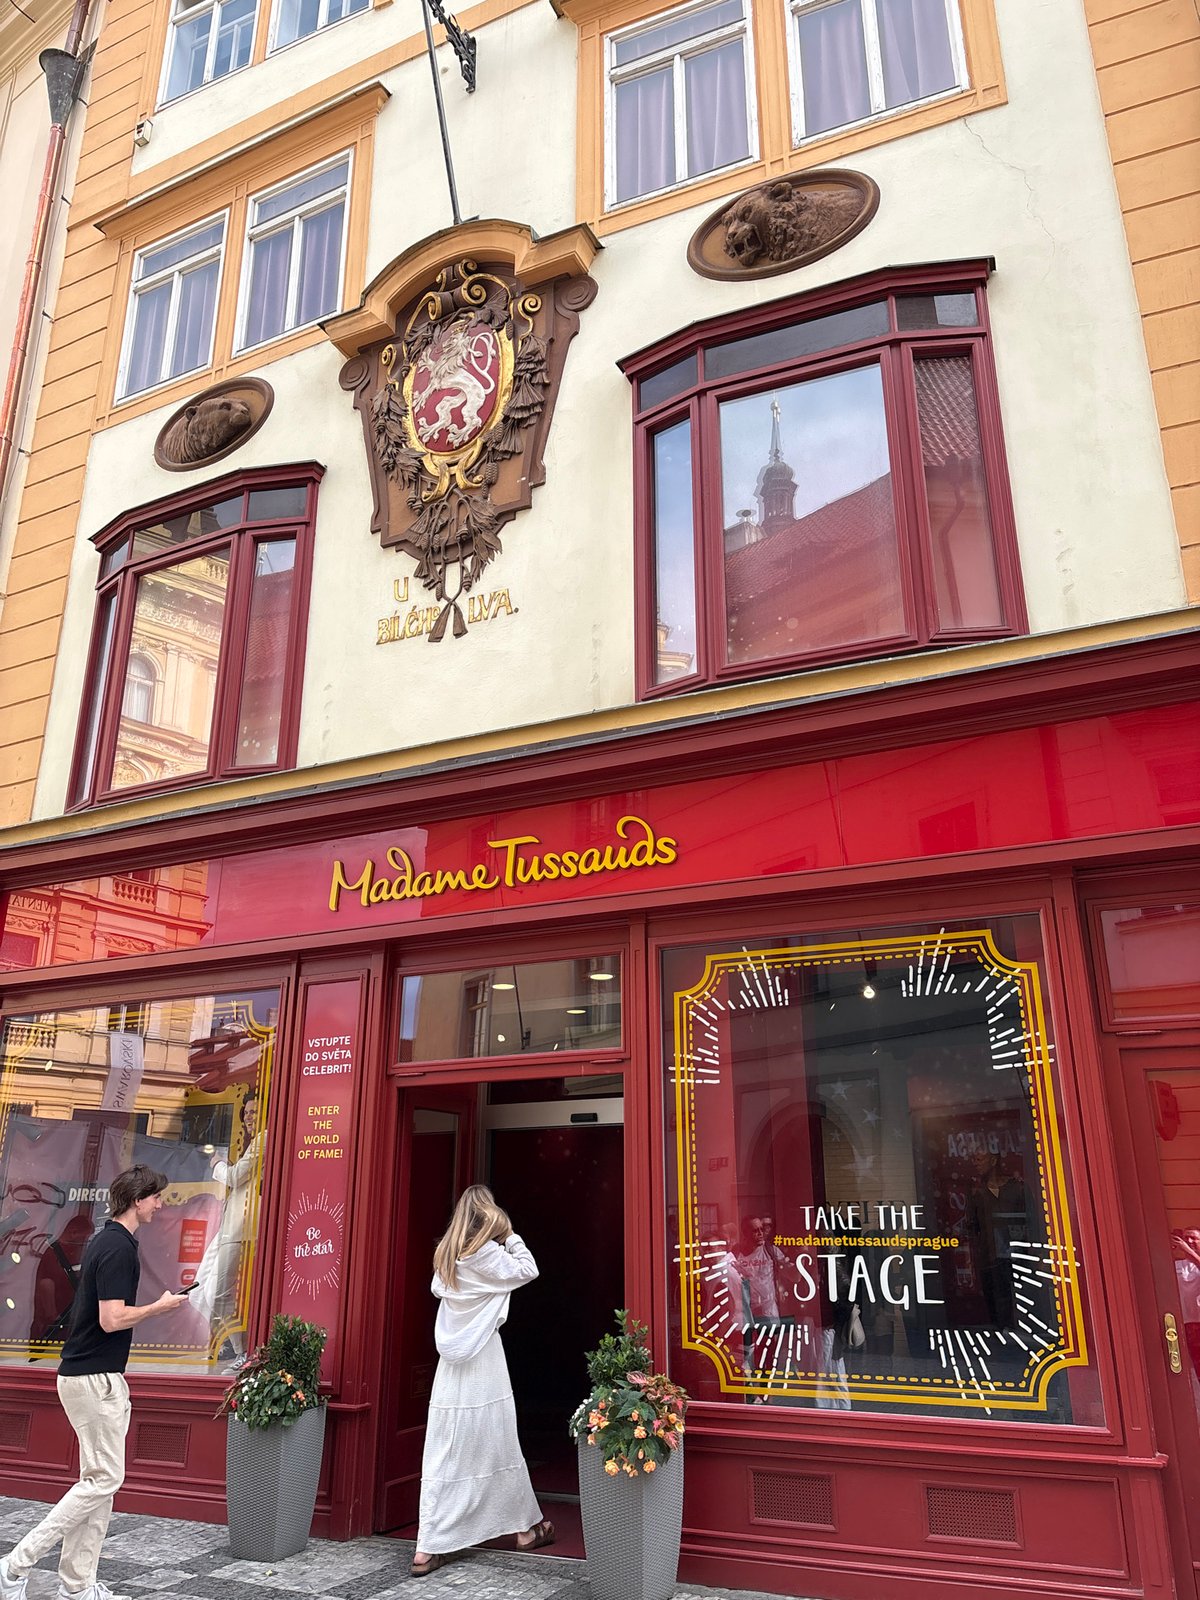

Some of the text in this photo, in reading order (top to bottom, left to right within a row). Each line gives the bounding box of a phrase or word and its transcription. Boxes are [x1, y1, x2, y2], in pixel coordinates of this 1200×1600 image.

[393, 576, 409, 602] U
[328, 815, 678, 912] Madame Tussauds
[308, 1035, 351, 1048] VSTUPTE
[305, 1047, 352, 1062] DO SVĚTA
[303, 1063, 352, 1076] CELEBRIT!
[307, 1105, 340, 1116] ENTER
[312, 1120, 333, 1130] THE
[303, 1134, 340, 1145] WORLD
[297, 1148, 343, 1160] OF FAME!
[68, 1187, 111, 1202] DIRECT
[799, 1204, 862, 1231] TAKE
[873, 1204, 926, 1231] THE
[306, 1226, 322, 1241] Be
[293, 1238, 335, 1258] the star
[773, 1234, 960, 1250] #madametussaudsprague
[793, 1252, 946, 1311] STAGE
